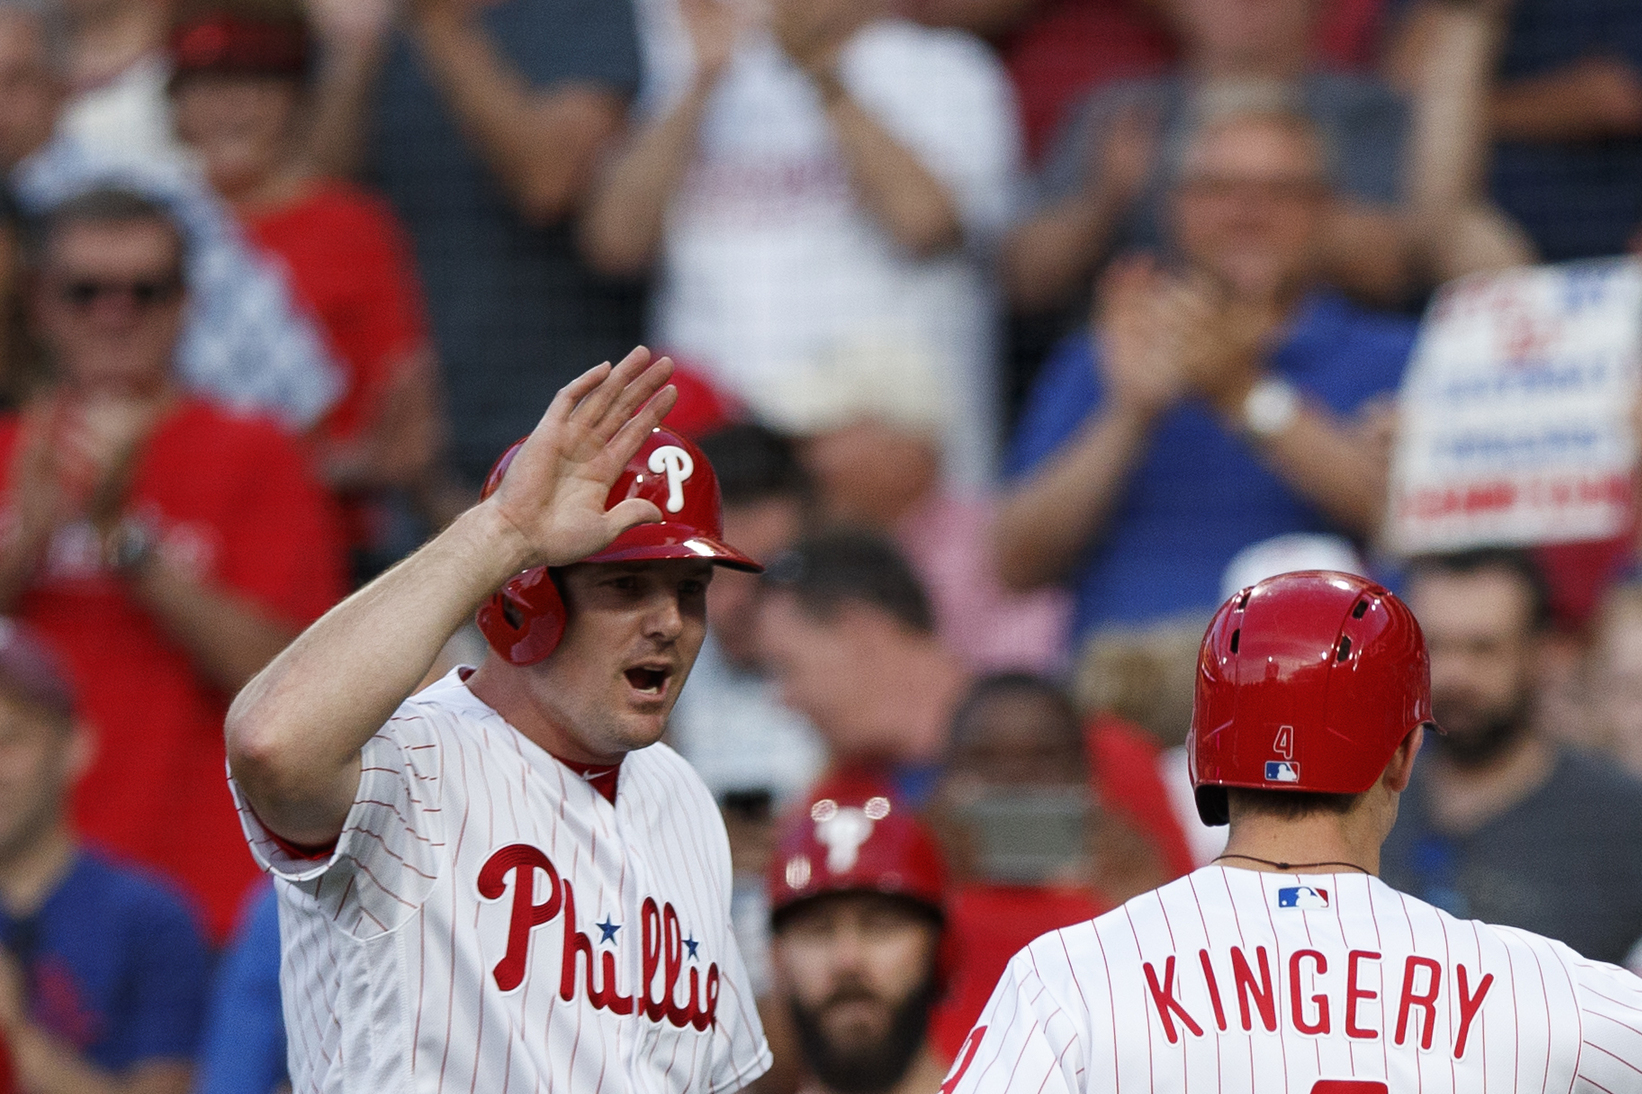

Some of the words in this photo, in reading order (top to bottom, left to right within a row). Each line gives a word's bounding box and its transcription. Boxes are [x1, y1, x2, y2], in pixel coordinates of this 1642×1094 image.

[647, 445, 694, 513] P
[1273, 725, 1293, 760] 4
[477, 843, 719, 1032] Phillie
[1143, 945, 1493, 1059] KINGERY
